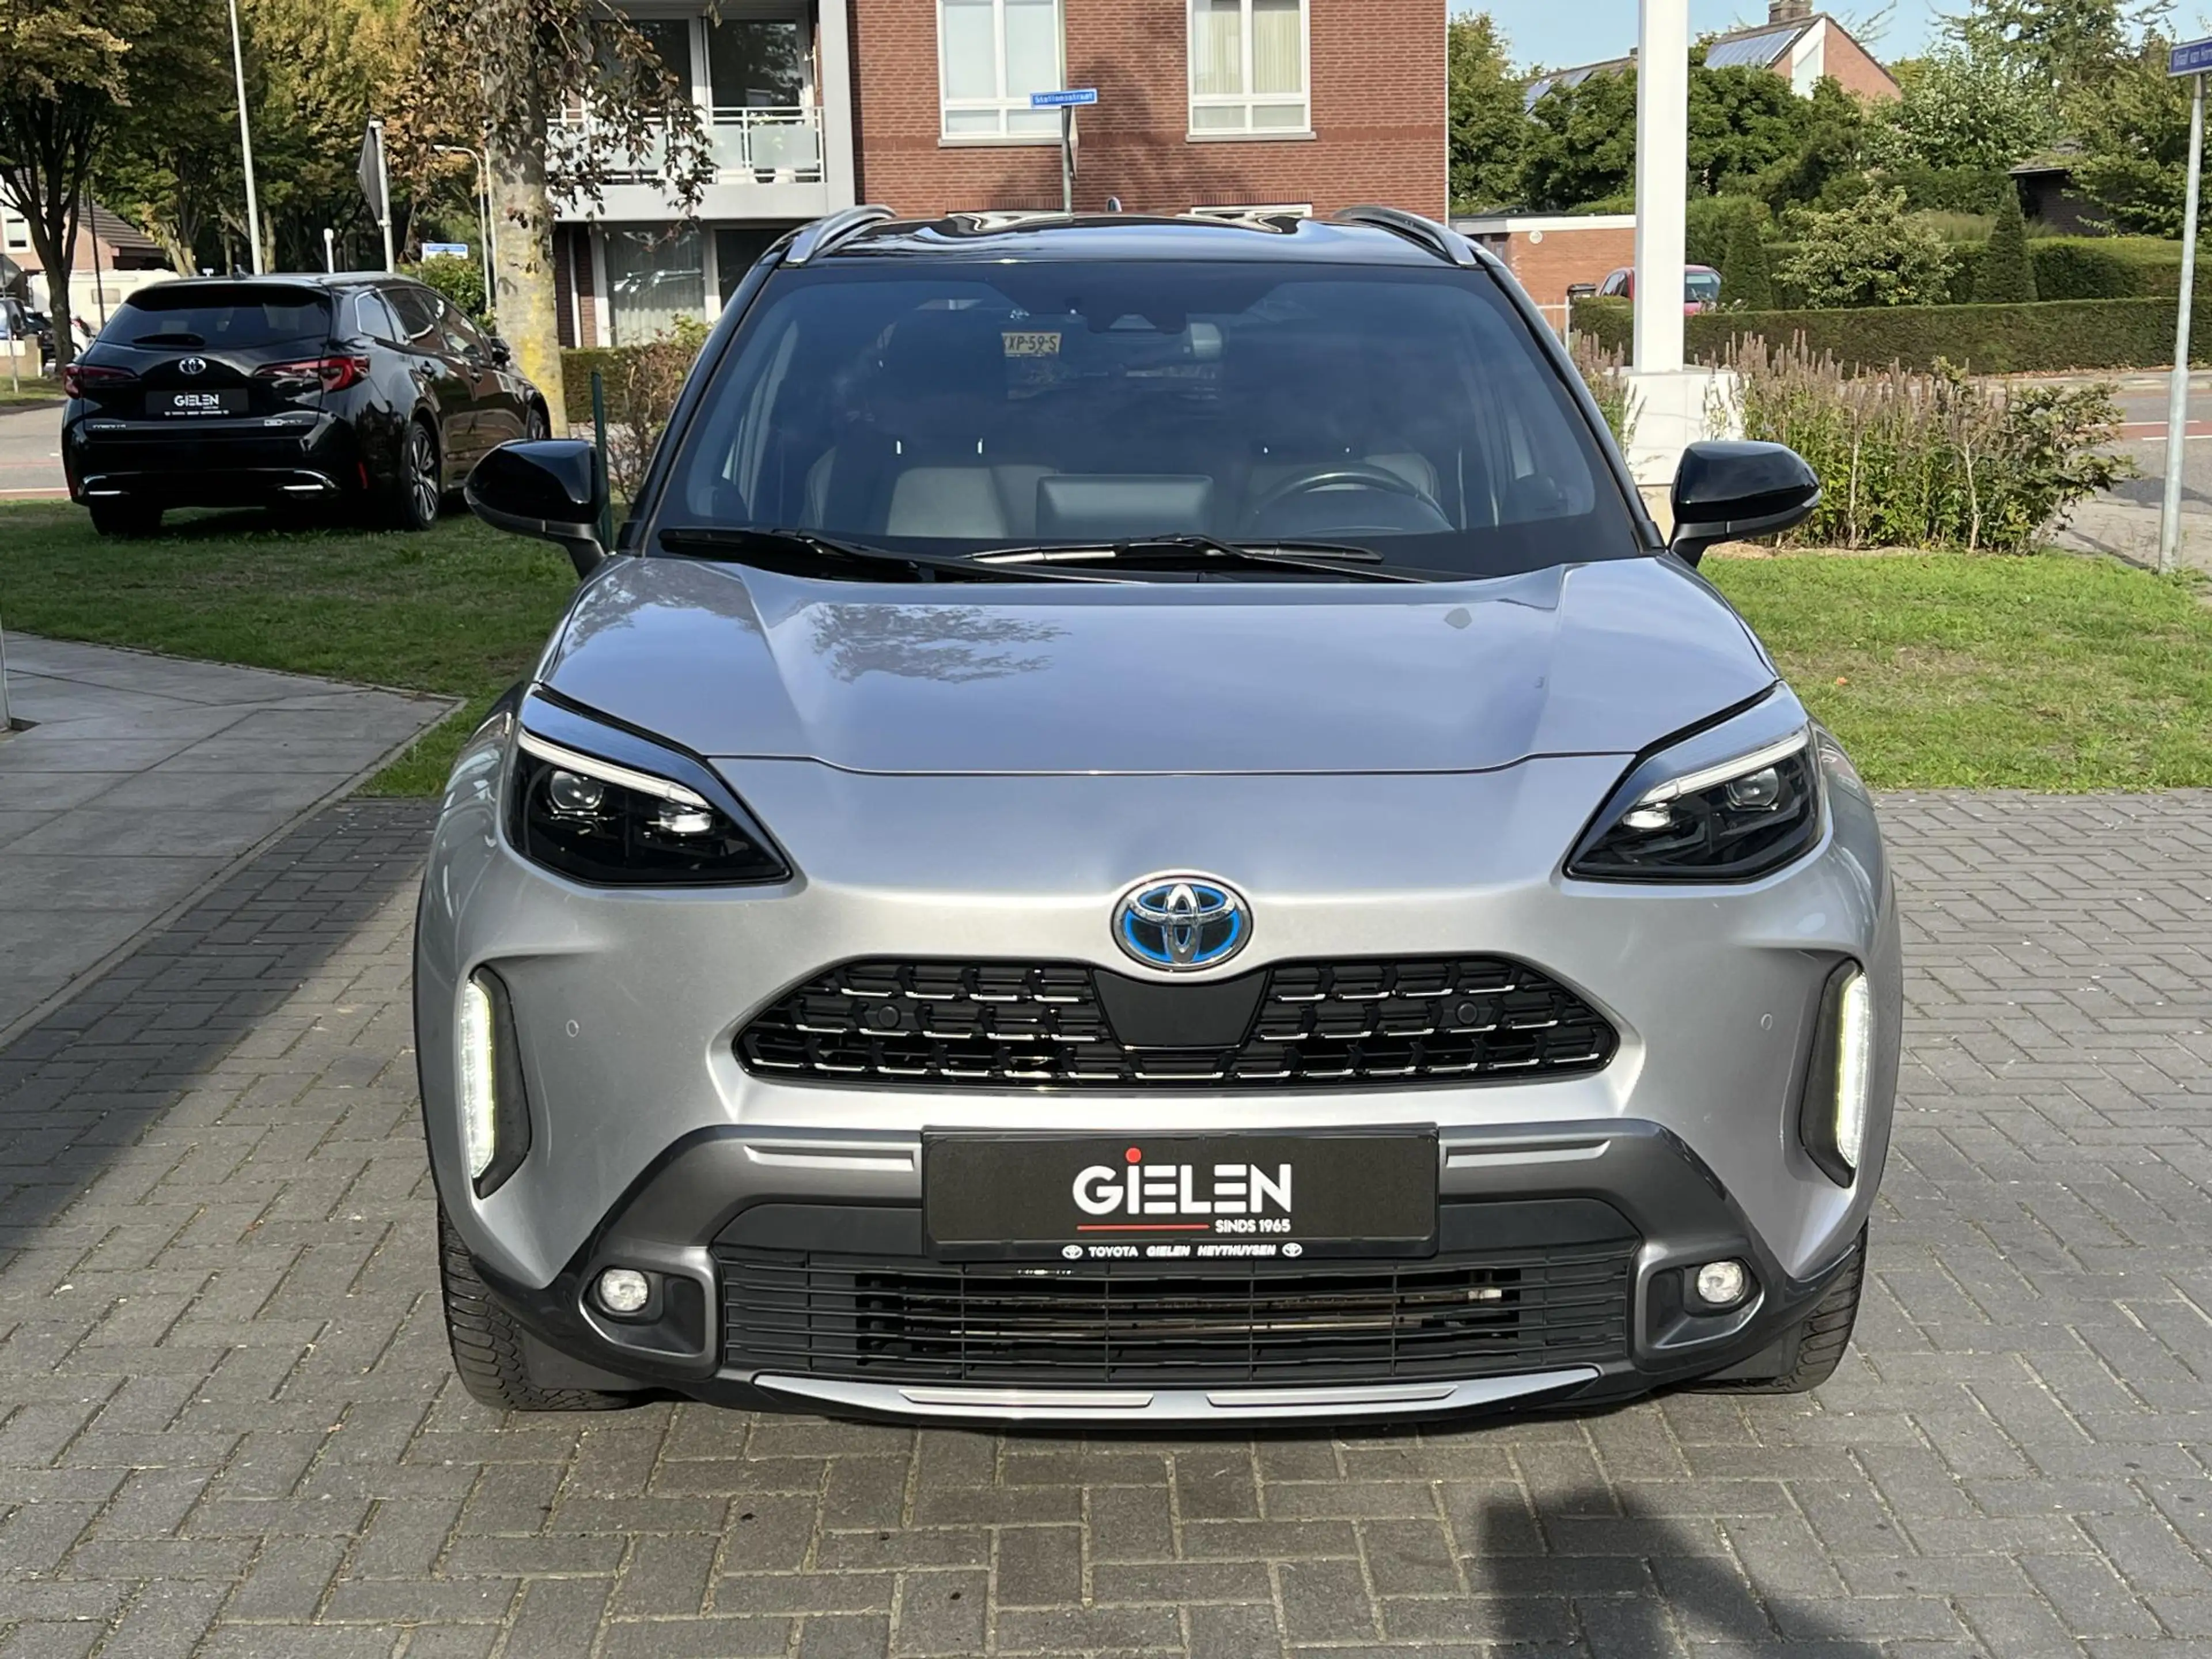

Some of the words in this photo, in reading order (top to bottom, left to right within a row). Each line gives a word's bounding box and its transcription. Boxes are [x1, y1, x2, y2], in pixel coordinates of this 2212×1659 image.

[1214, 1218, 1256, 1233] SINDS
[1259, 1218, 1291, 1233] 1965
[1088, 1245, 1139, 1258] TOYOTA
[1146, 1245, 1191, 1257] GIELEN
[1197, 1244, 1277, 1257] HEYTHUYSEN
